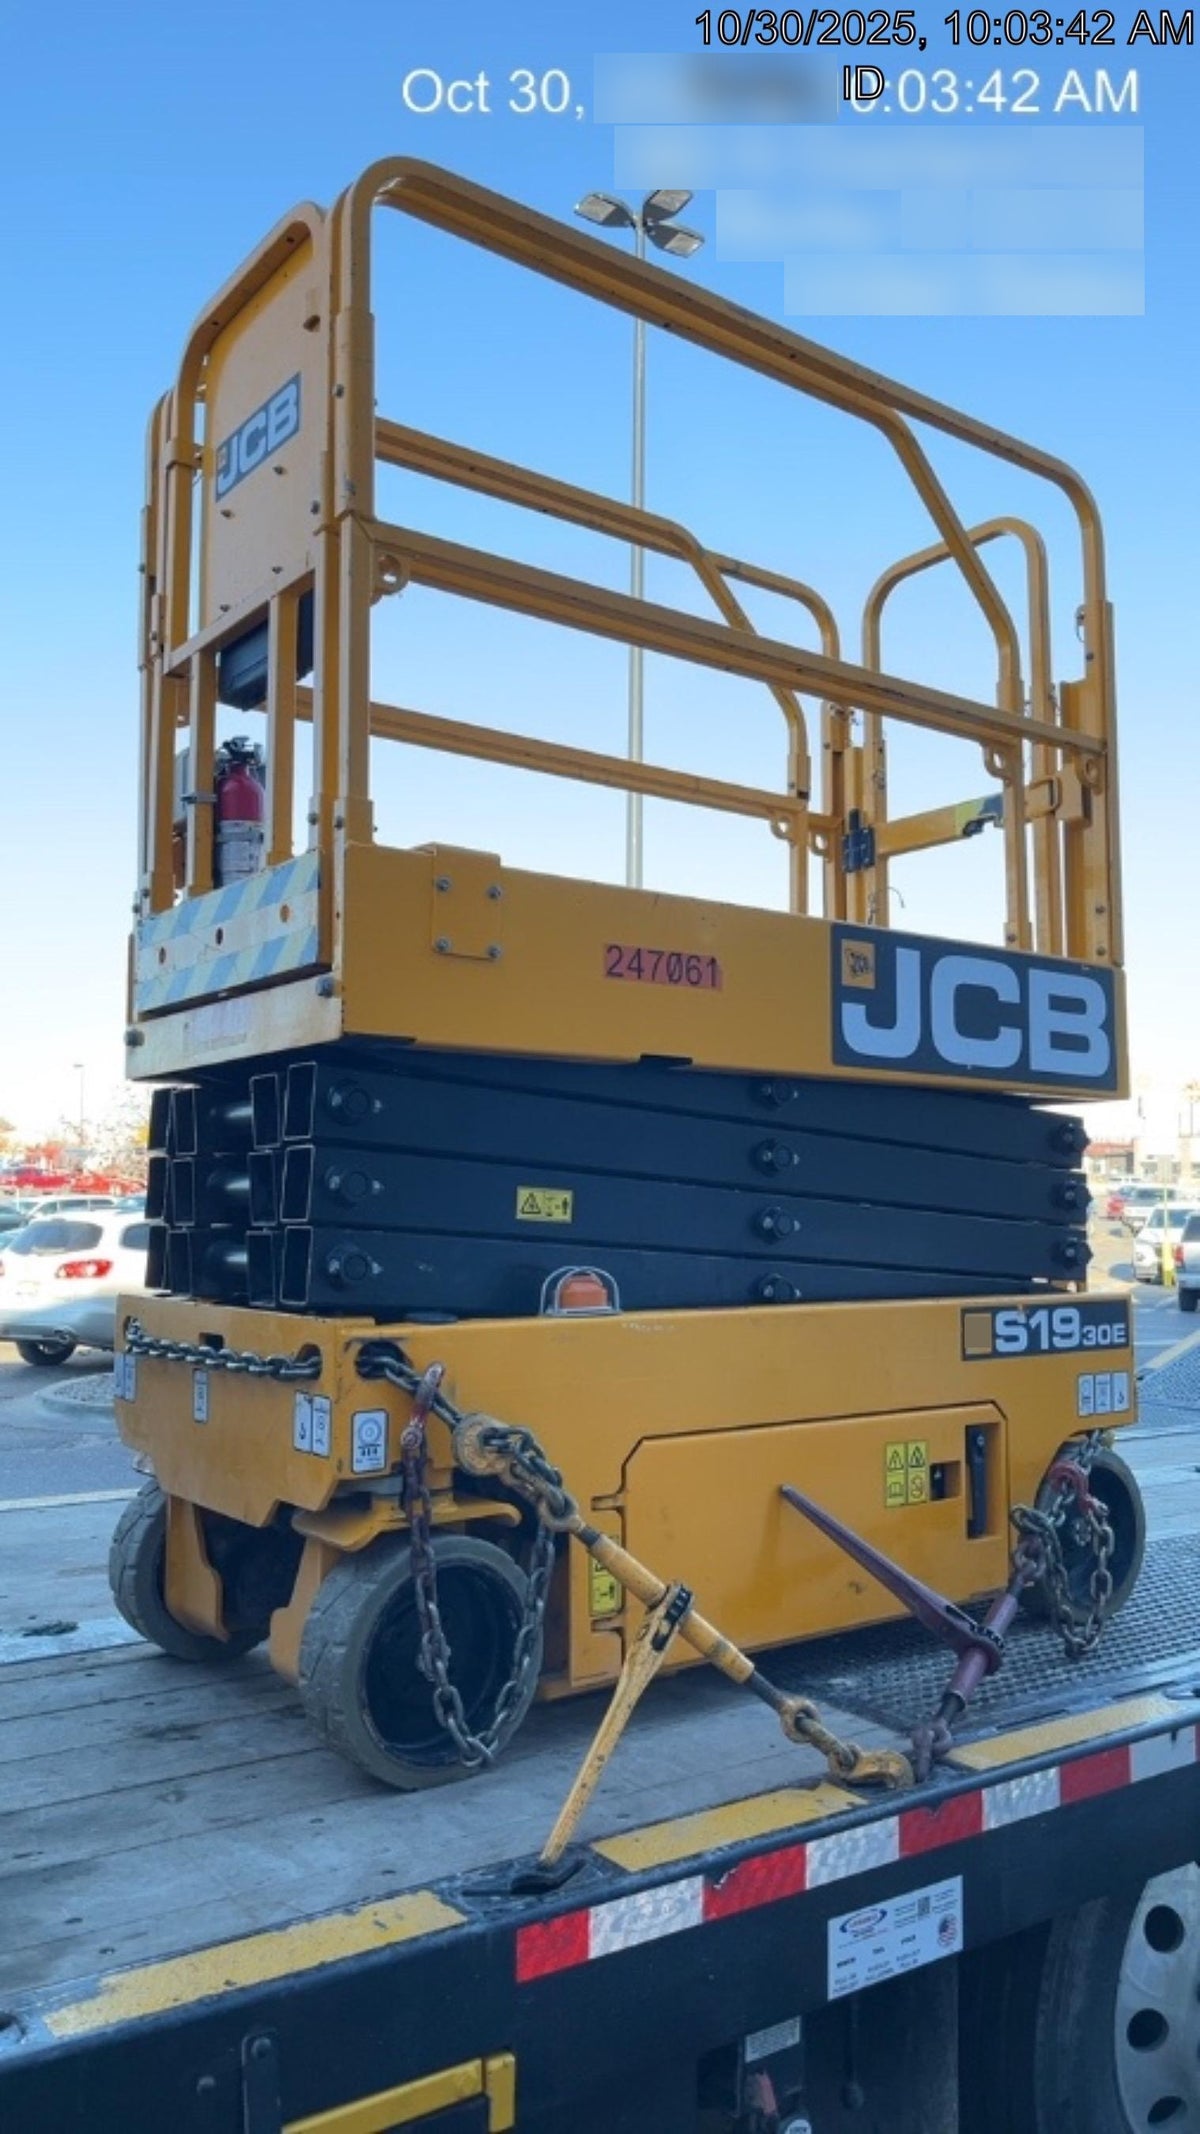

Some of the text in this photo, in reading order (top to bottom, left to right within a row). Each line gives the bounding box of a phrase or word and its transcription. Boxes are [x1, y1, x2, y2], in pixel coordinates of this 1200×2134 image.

[217, 382, 299, 497] JCB
[606, 945, 717, 988] 247061
[841, 947, 1111, 1078] JCB
